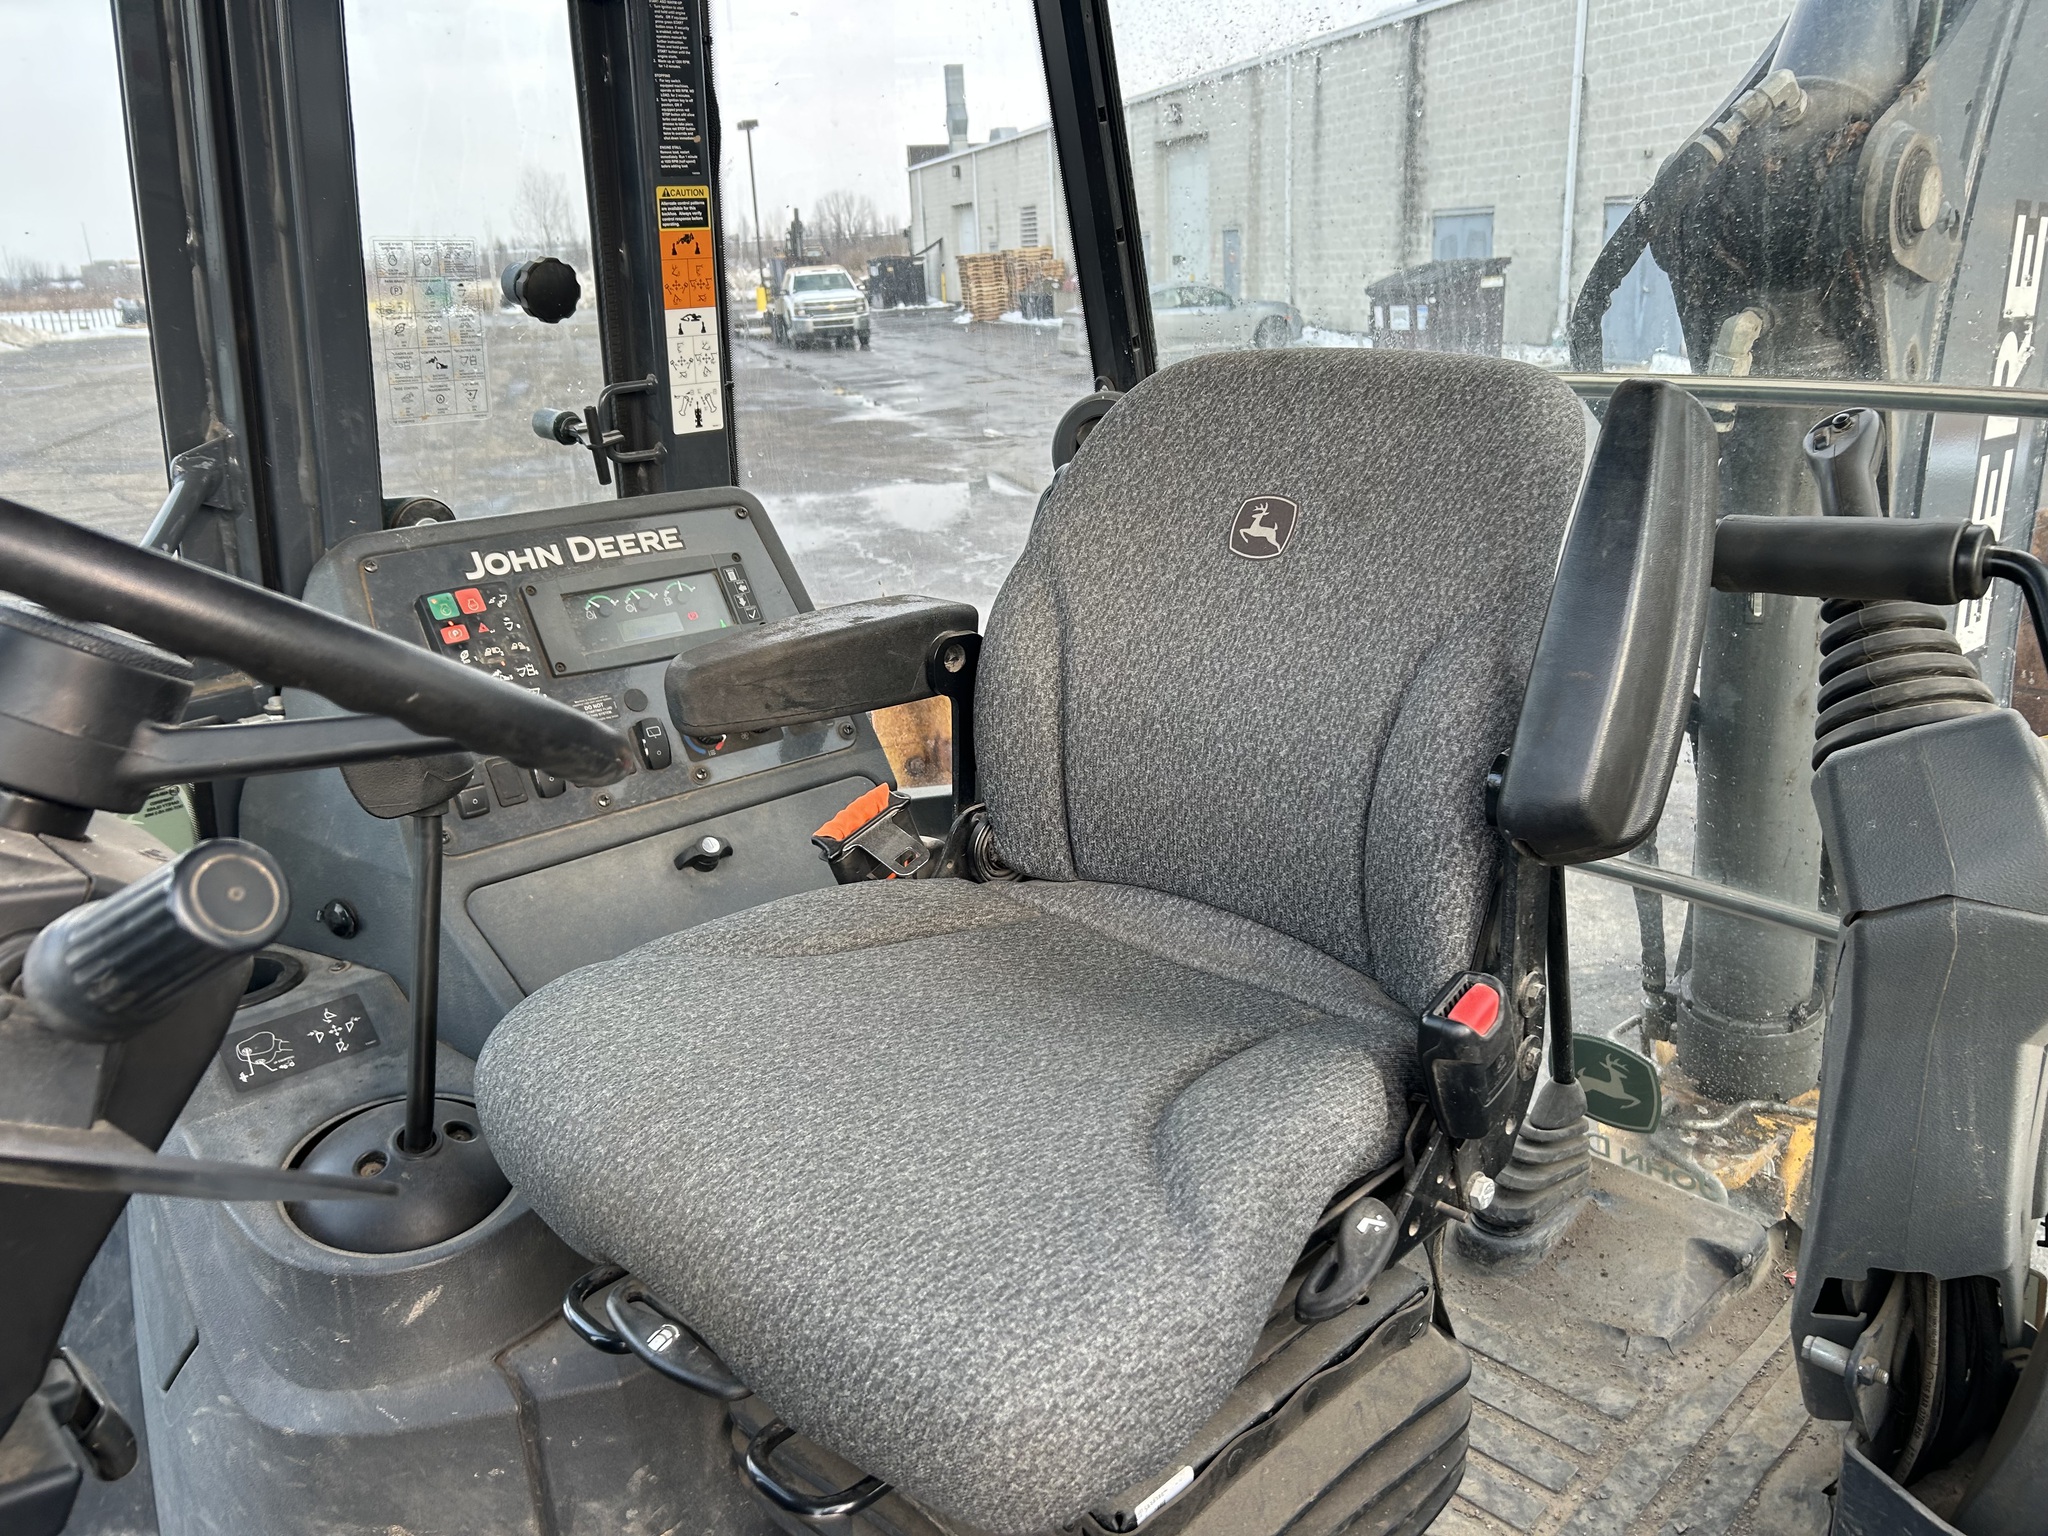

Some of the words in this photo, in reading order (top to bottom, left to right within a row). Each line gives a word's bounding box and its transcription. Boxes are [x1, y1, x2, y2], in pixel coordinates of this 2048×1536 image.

[670, 189, 704, 197] CAUTION
[1954, 213, 2048, 656] EERE
[465, 543, 563, 581] JOHN
[566, 527, 683, 563] DEERE
[593, 702, 604, 710] NOT
